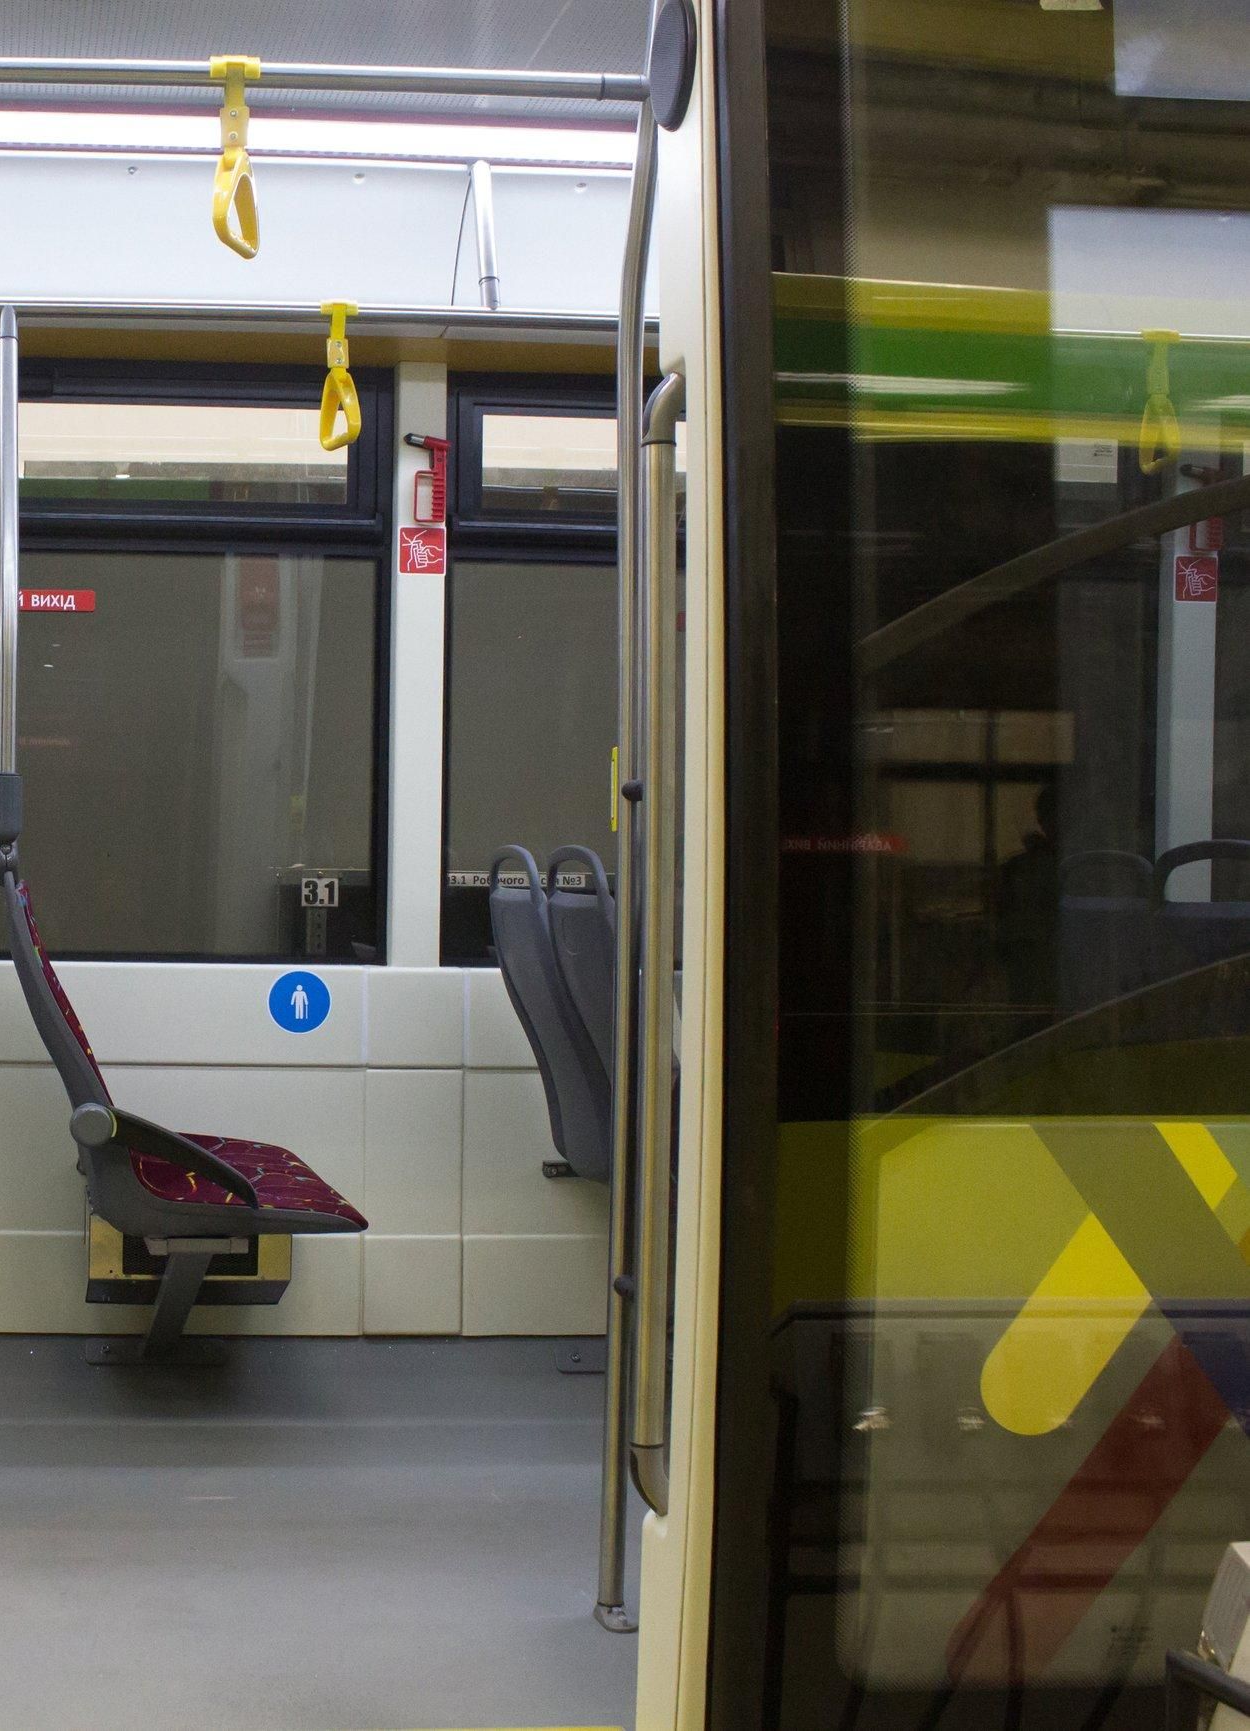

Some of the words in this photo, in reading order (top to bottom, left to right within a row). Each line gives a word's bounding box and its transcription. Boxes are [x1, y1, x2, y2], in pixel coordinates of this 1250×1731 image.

[31, 595, 76, 610] ВИХІД
[473, 876, 525, 886] Робчого
[304, 880, 335, 905] 3.1
